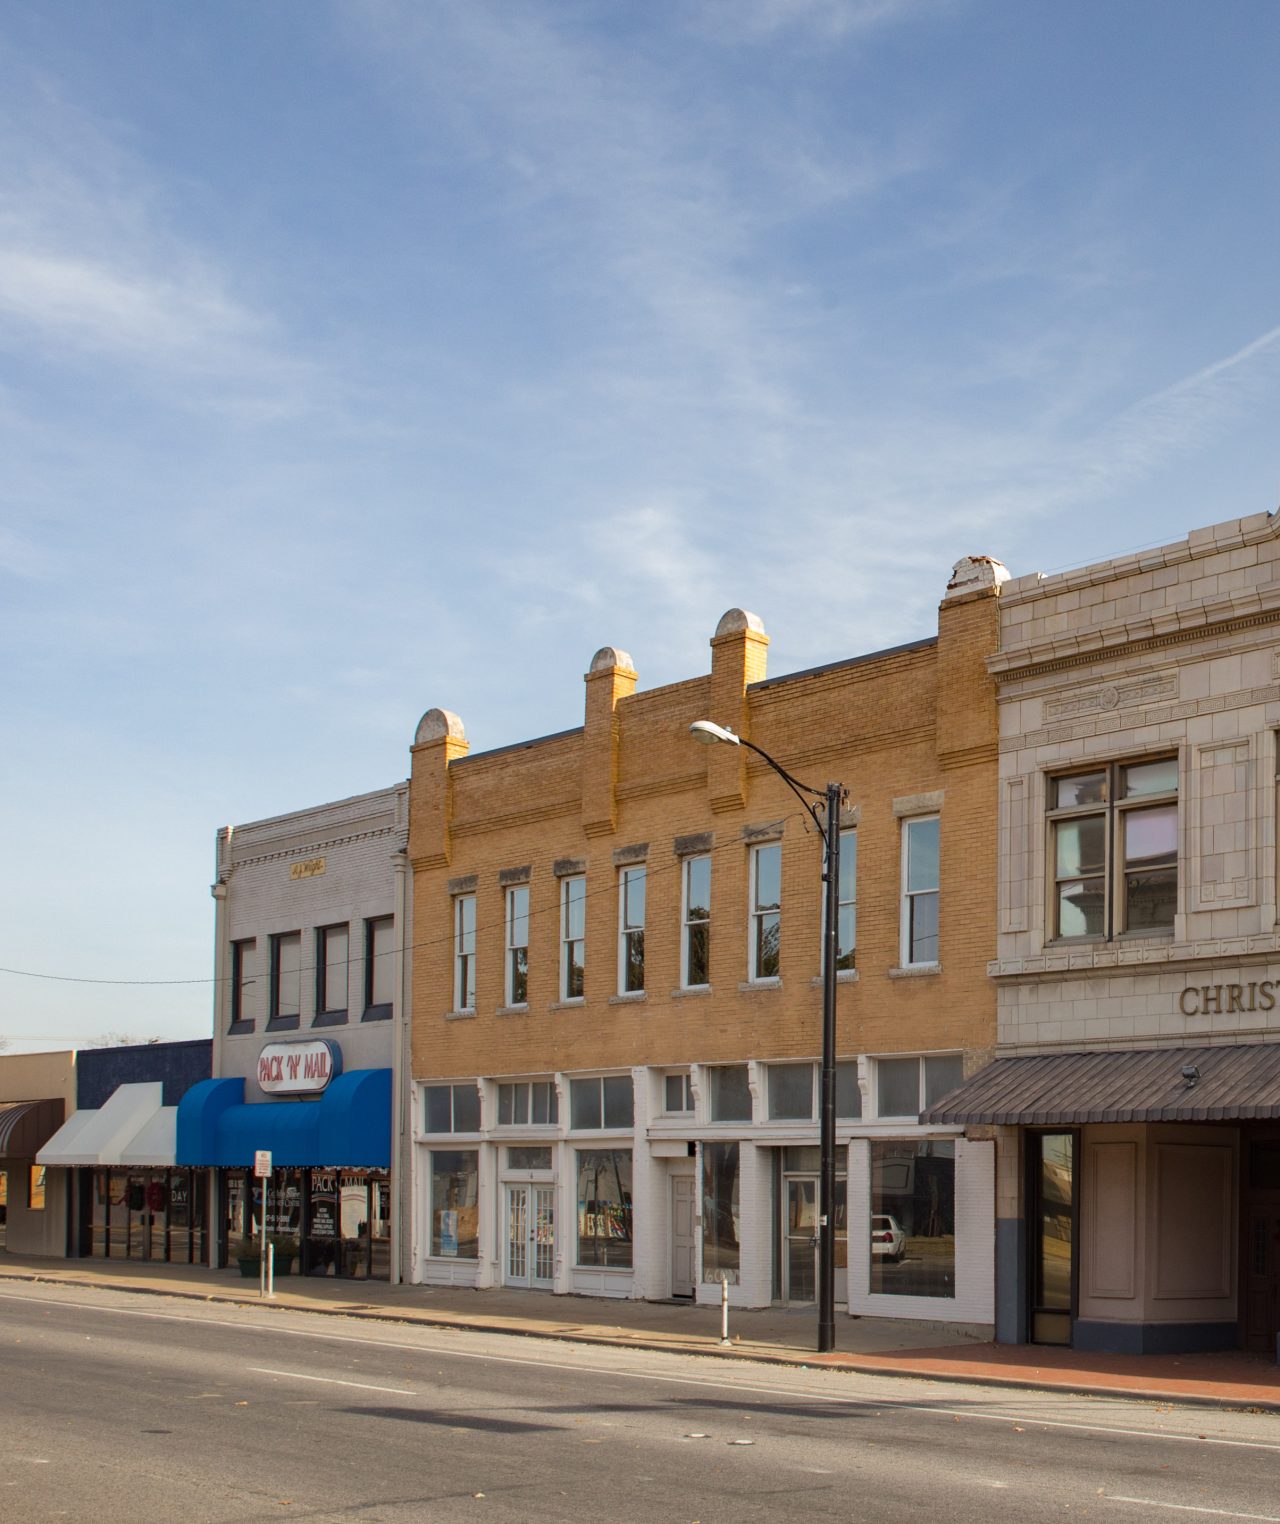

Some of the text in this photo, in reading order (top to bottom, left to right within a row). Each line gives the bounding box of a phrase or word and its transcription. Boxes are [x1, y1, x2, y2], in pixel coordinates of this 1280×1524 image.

[260, 1055, 284, 1082] PACK
[304, 1052, 328, 1079] MAIL
[311, 1176, 334, 1192] PACK
[171, 1190, 187, 1202] DAY
